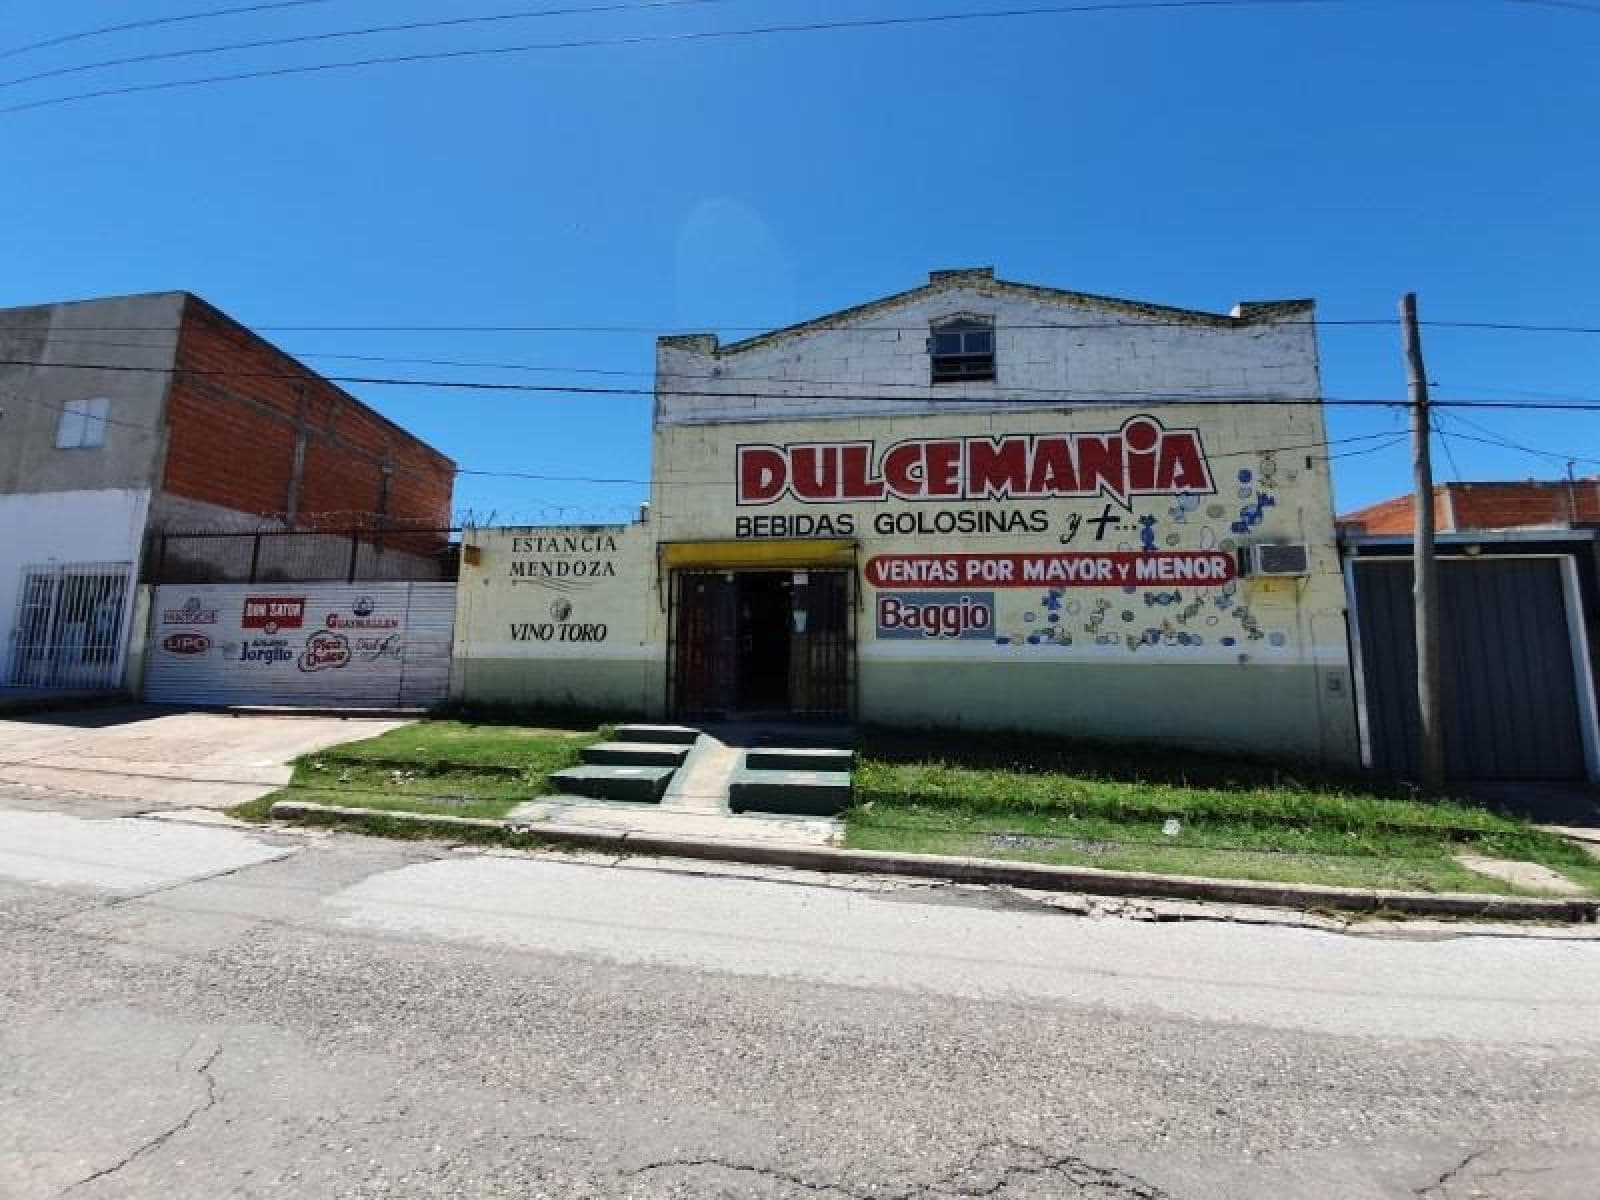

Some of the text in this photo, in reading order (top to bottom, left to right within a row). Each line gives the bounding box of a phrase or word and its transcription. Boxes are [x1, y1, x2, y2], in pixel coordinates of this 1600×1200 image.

[736, 514, 855, 538] BEBIDAS
[874, 510, 1050, 535] GOLOSINAS
[512, 535, 617, 553] ESTANCIA
[509, 559, 617, 577] MENDOZA
[875, 558, 959, 582] VENTAS
[965, 558, 1014, 581] POR
[1023, 557, 1113, 581] MAYOR
[1135, 556, 1227, 579] MENOR
[878, 595, 991, 638] Baggio
[509, 623, 608, 642] VINO TORO
